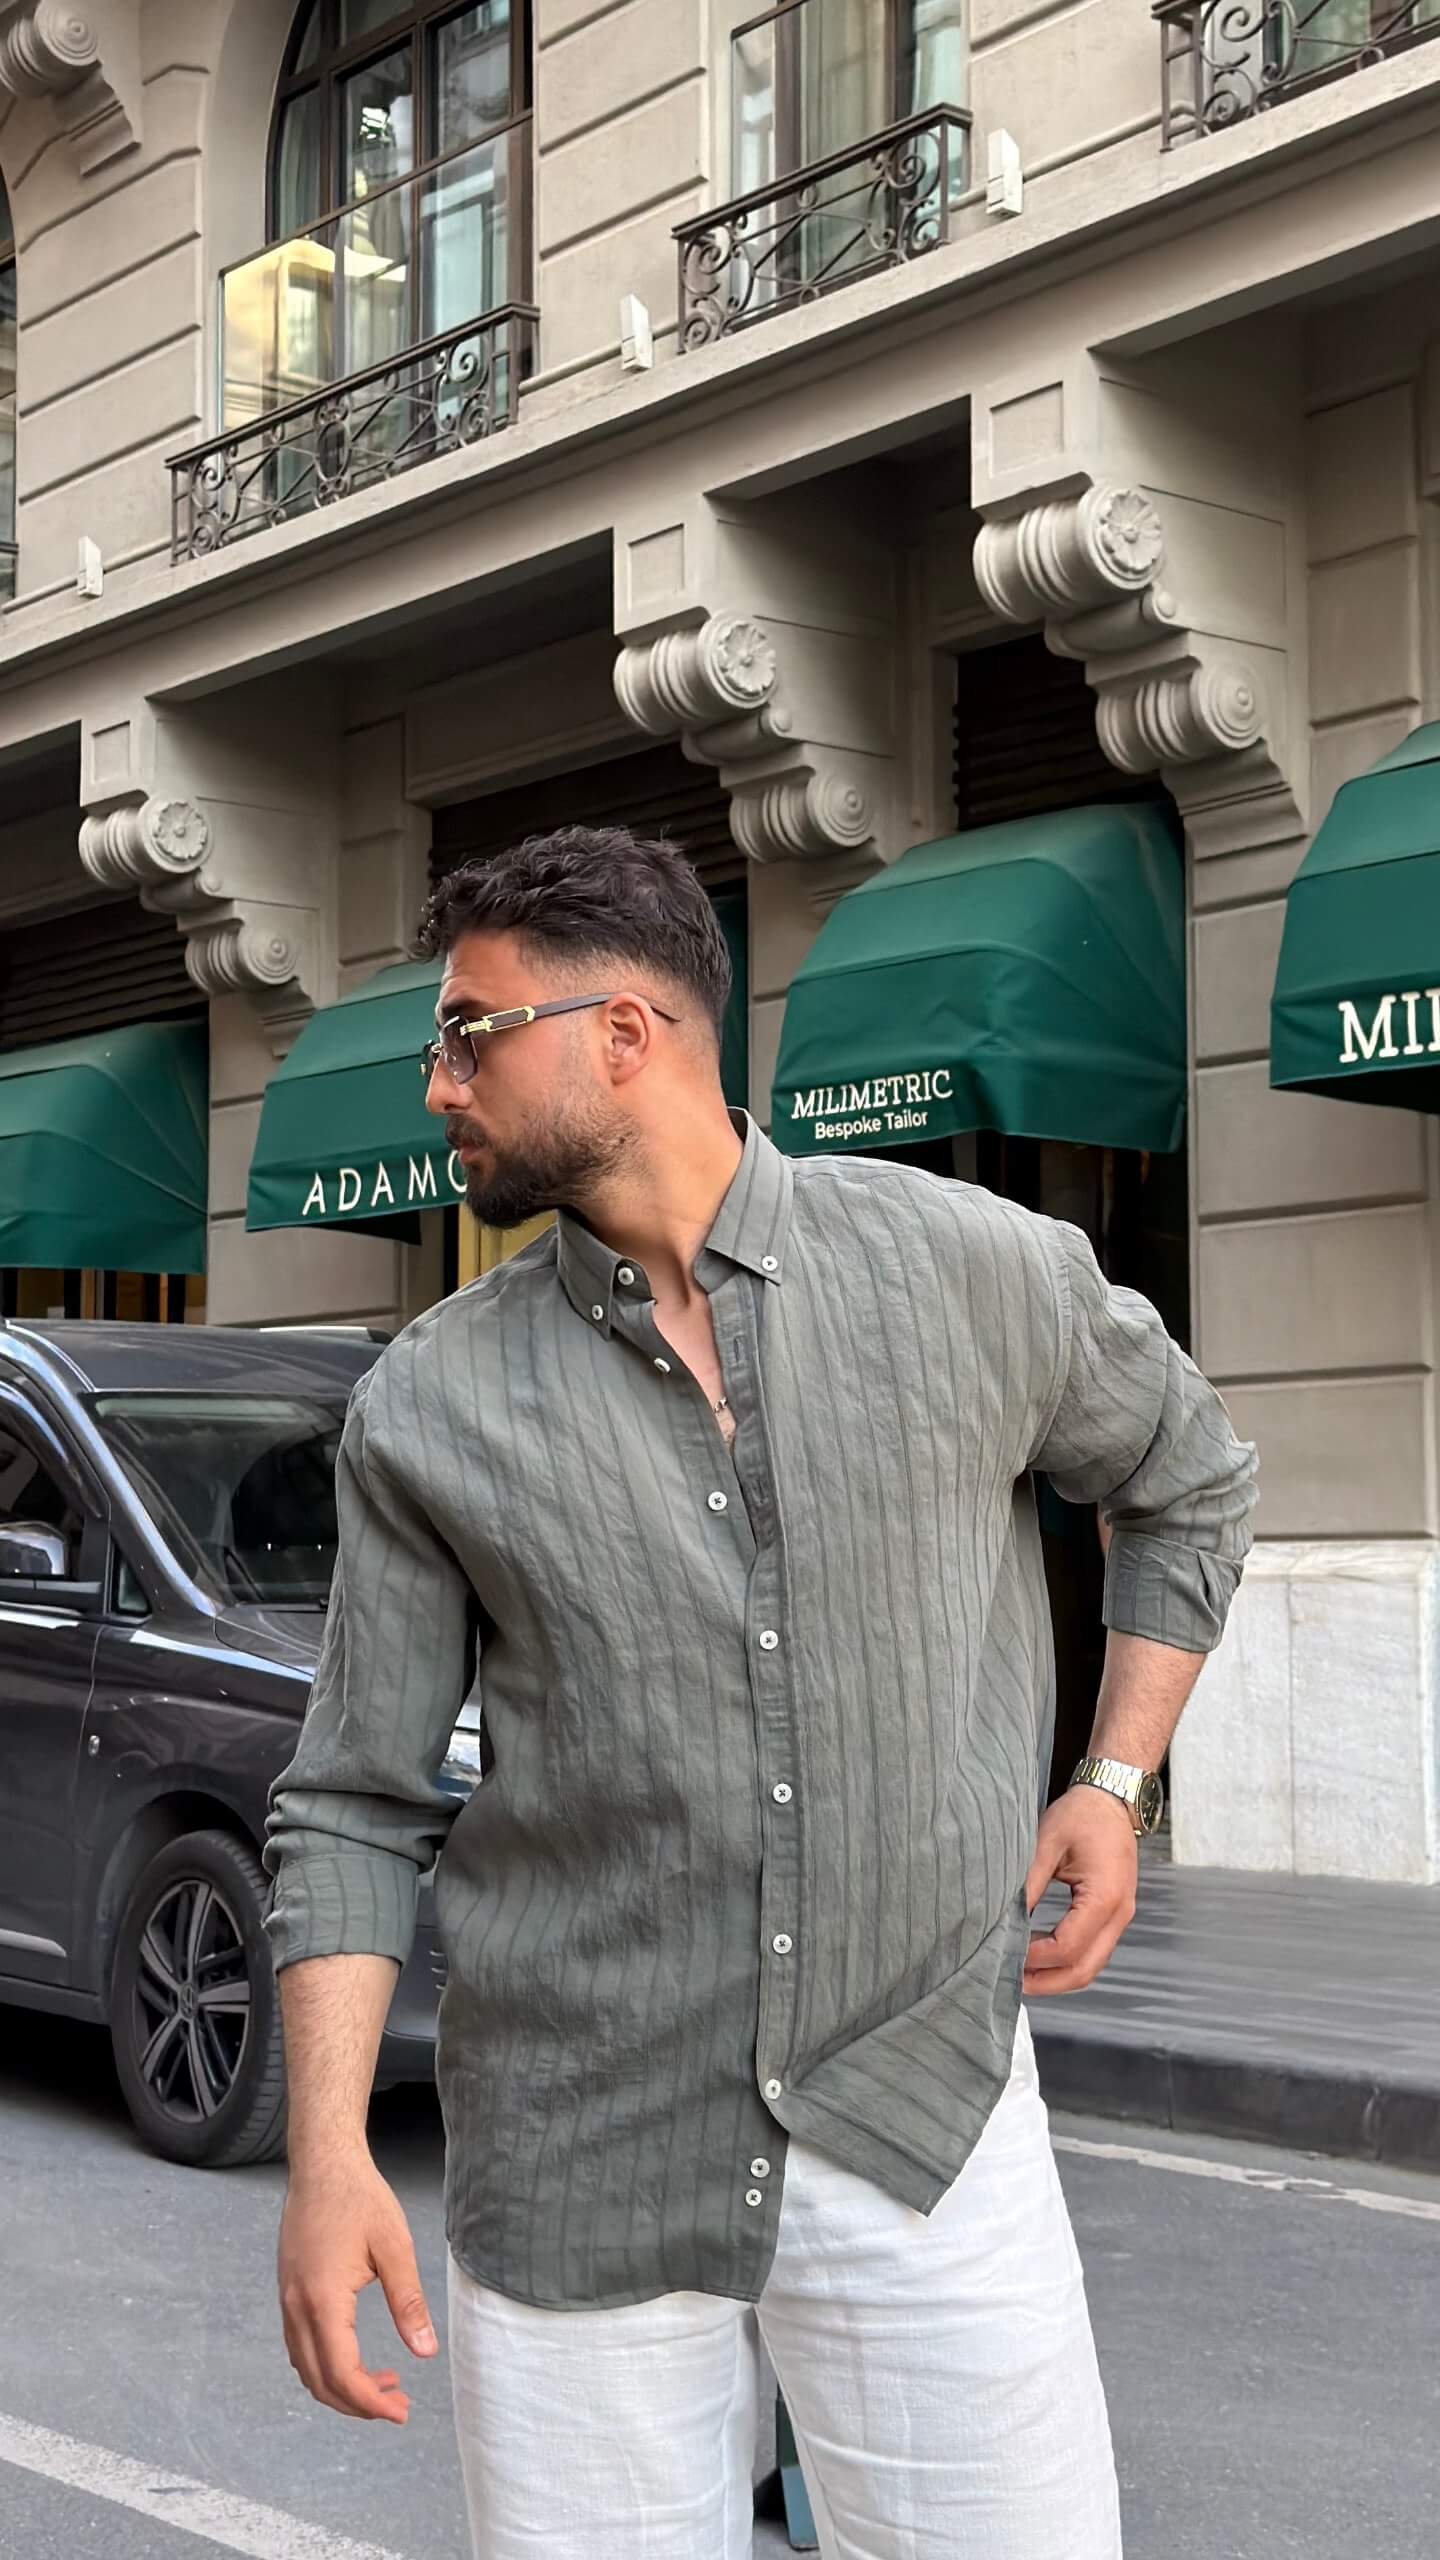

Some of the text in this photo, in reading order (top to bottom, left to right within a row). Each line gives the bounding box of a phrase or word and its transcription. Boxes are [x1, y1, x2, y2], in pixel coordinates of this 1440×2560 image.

[790, 1069, 954, 1120] MILIMETRIC
[814, 1109, 929, 1140] Bespoke Tailor
